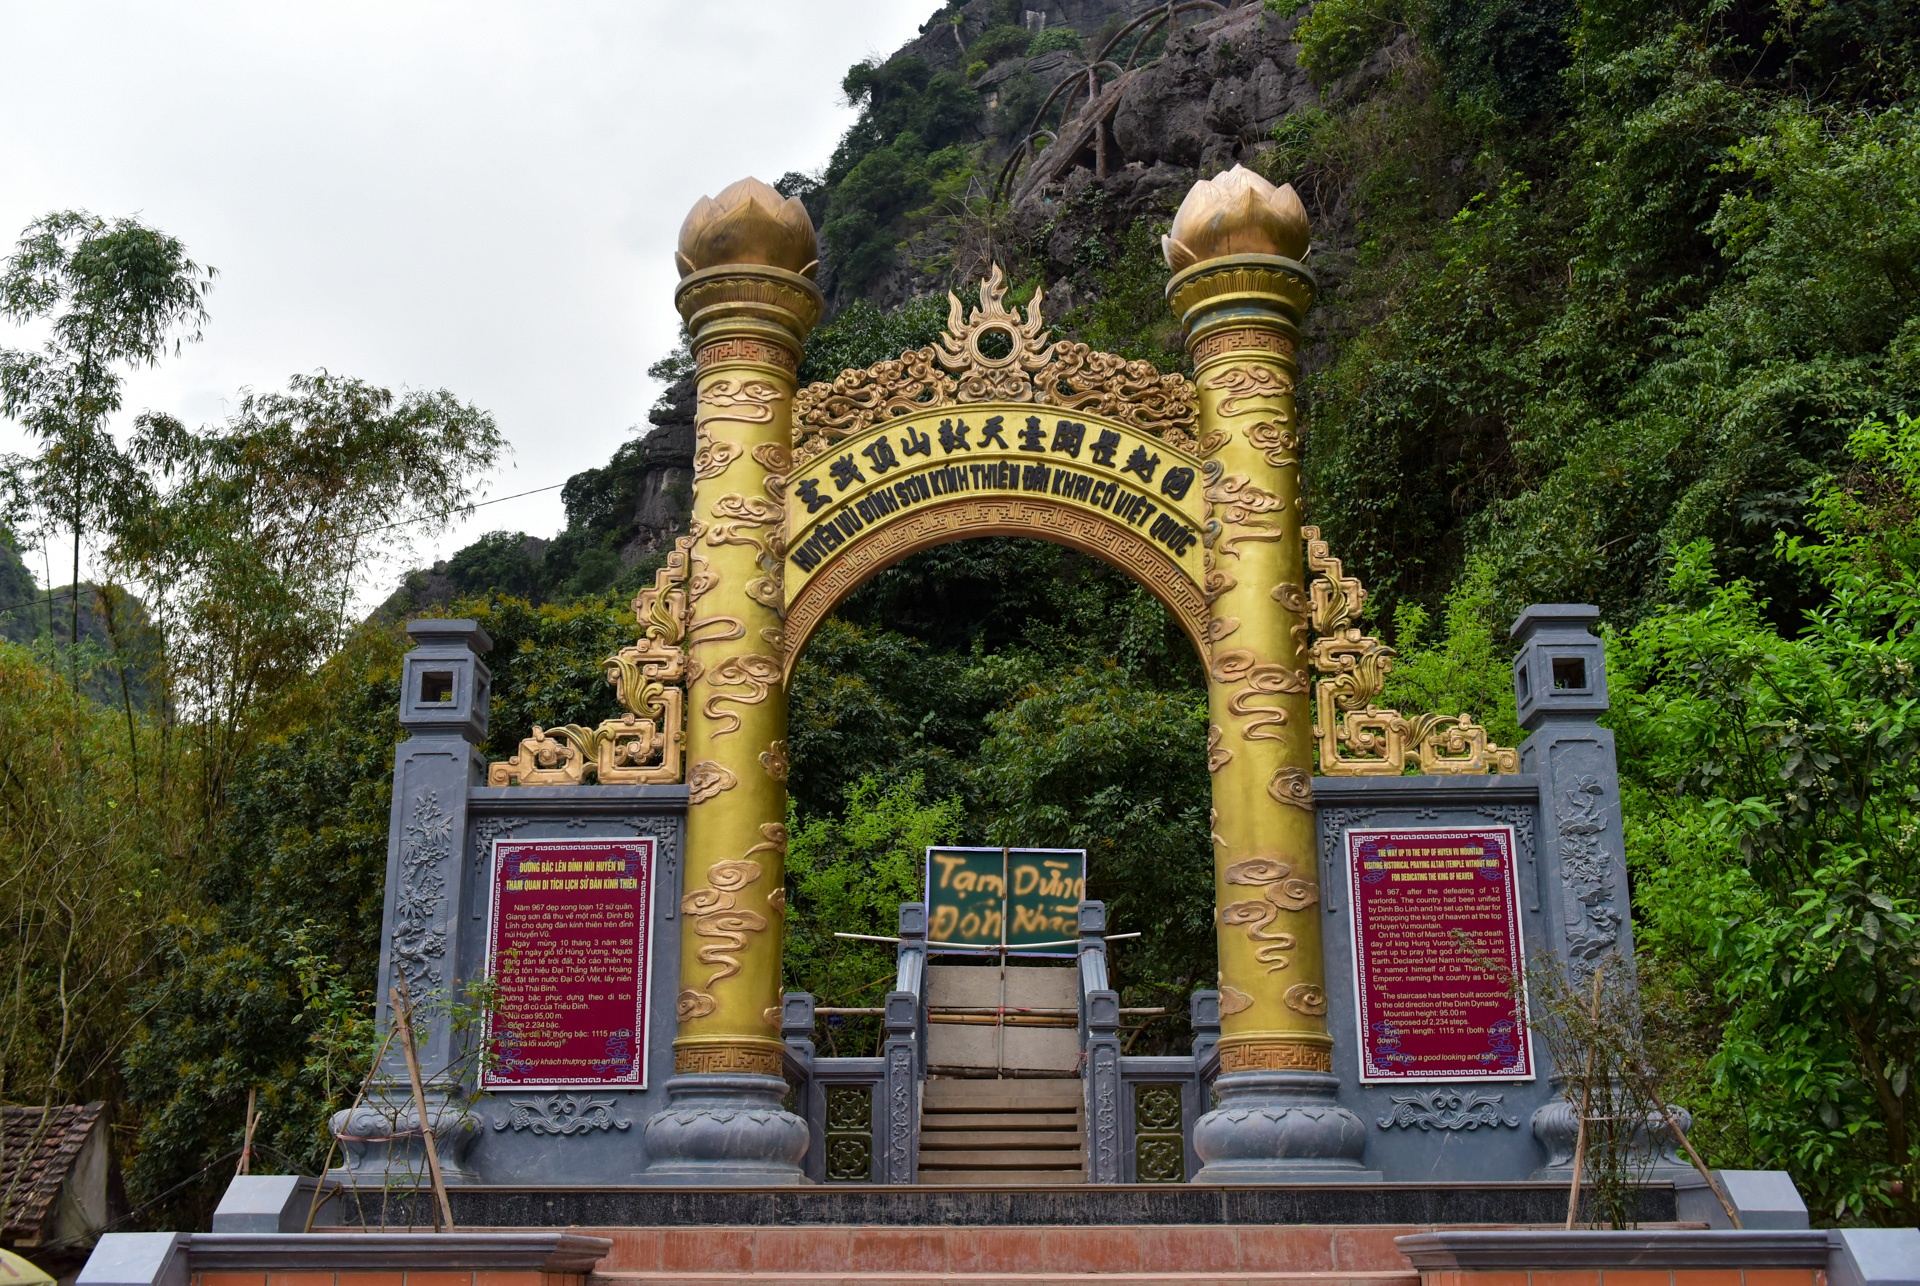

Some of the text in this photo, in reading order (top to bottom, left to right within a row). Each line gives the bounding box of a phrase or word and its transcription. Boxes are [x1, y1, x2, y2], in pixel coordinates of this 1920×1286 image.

[894, 475, 931, 507] SƠN
[928, 463, 970, 496] KÍNH
[970, 460, 1021, 490] THIÊN
[1022, 462, 1052, 493] ĐÀI
[1051, 468, 1094, 502] KHAI
[1112, 490, 1158, 528] VIỆT
[1149, 512, 1197, 557] QUỐC
[934, 854, 1003, 898] Tạm
[928, 898, 1002, 940] Đón
[1474, 990, 1508, 998] according
[1470, 999, 1498, 1008] Dynasty.
[1415, 1009, 1438, 1018] height:
[1383, 1018, 1420, 1027] Composed
